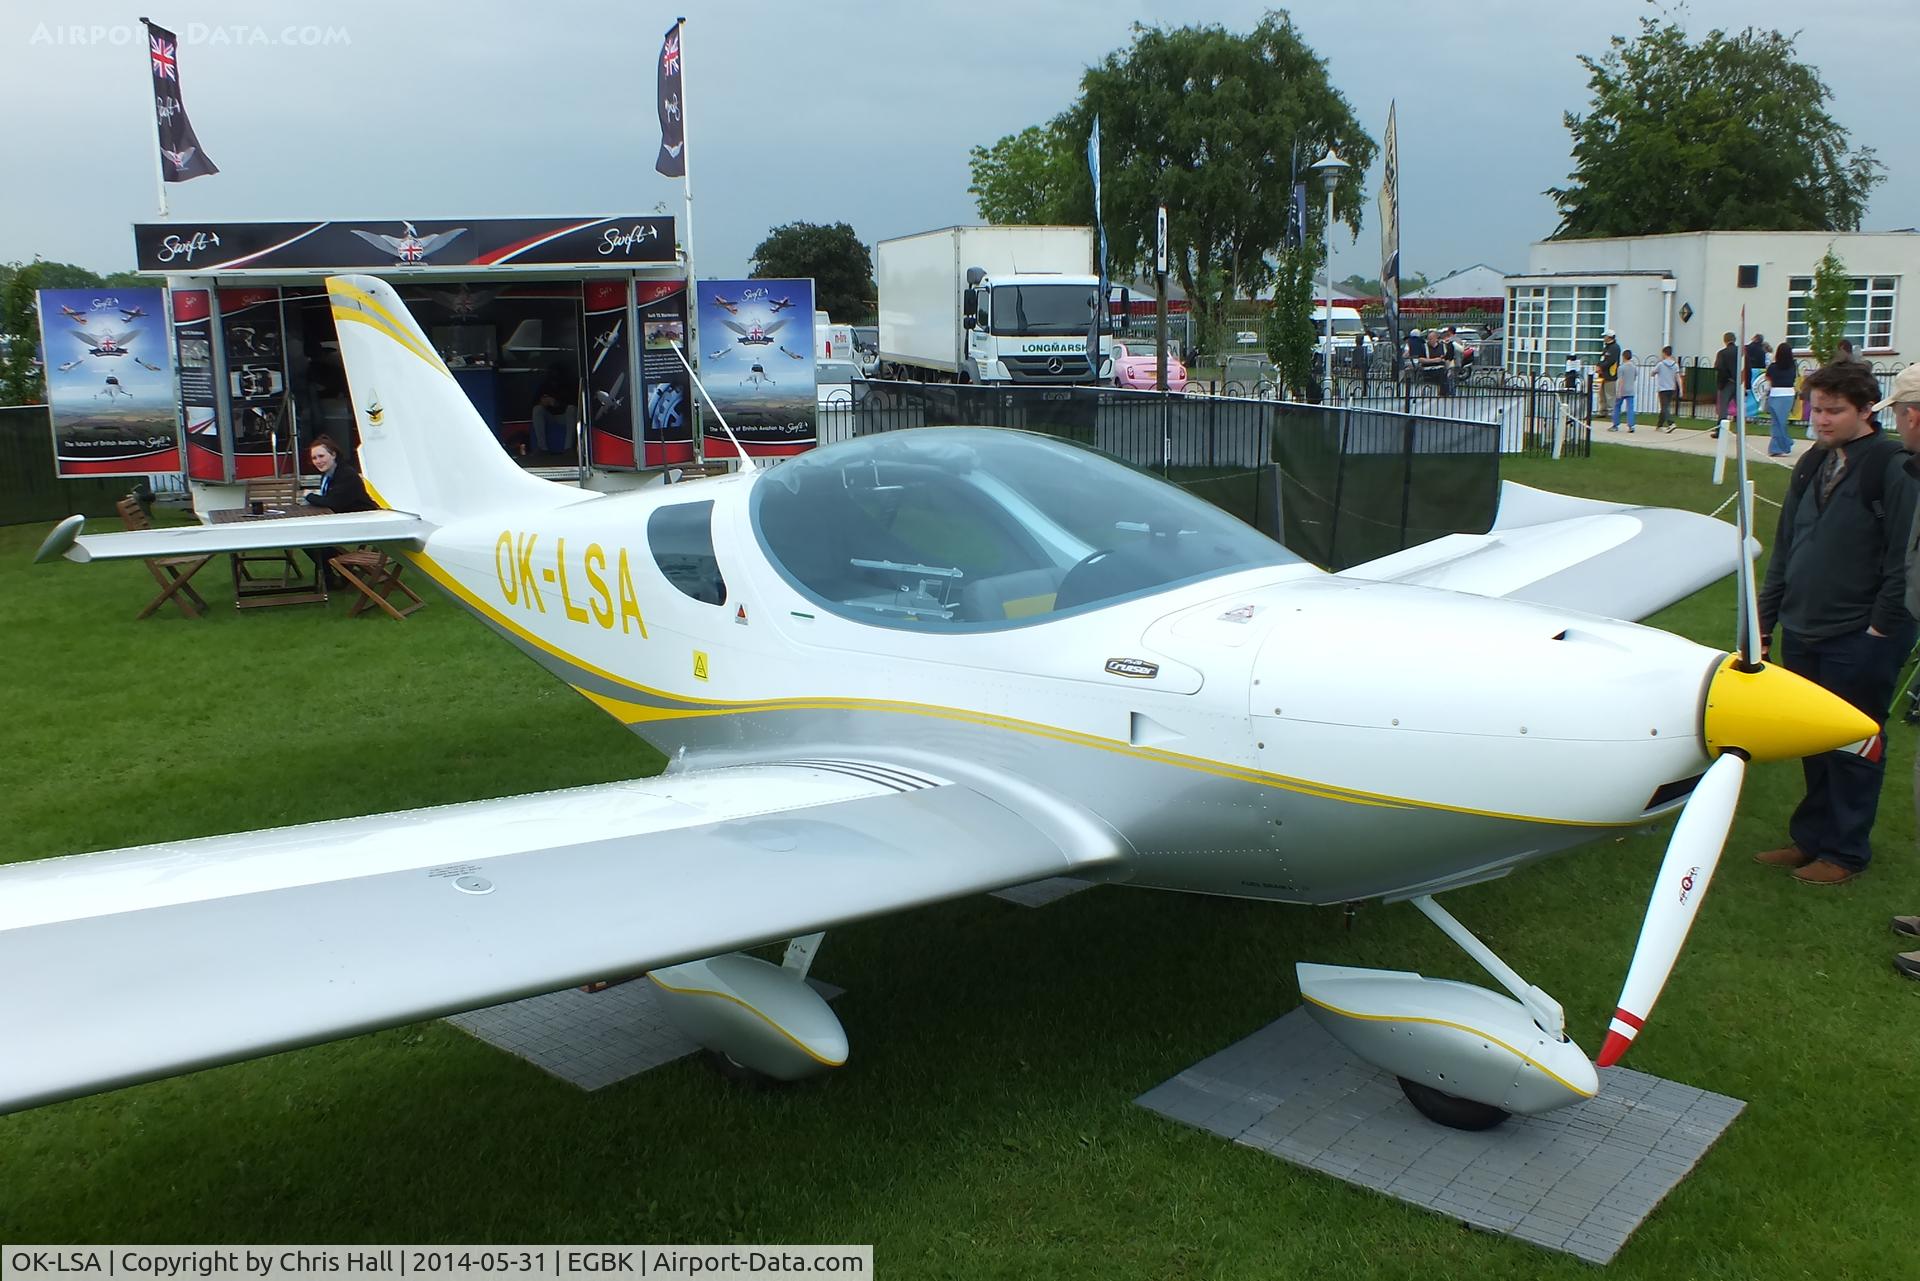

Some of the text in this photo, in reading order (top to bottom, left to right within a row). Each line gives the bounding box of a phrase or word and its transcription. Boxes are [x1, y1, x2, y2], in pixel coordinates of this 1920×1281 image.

[157, 231, 208, 262] Swift
[598, 225, 648, 255] Swift
[742, 287, 764, 302] Swift
[90, 298, 113, 312] Swift
[1022, 344, 1089, 352] LONGMARSH
[496, 530, 648, 640] OK-LSA
[1107, 661, 1156, 675] Cruiser
